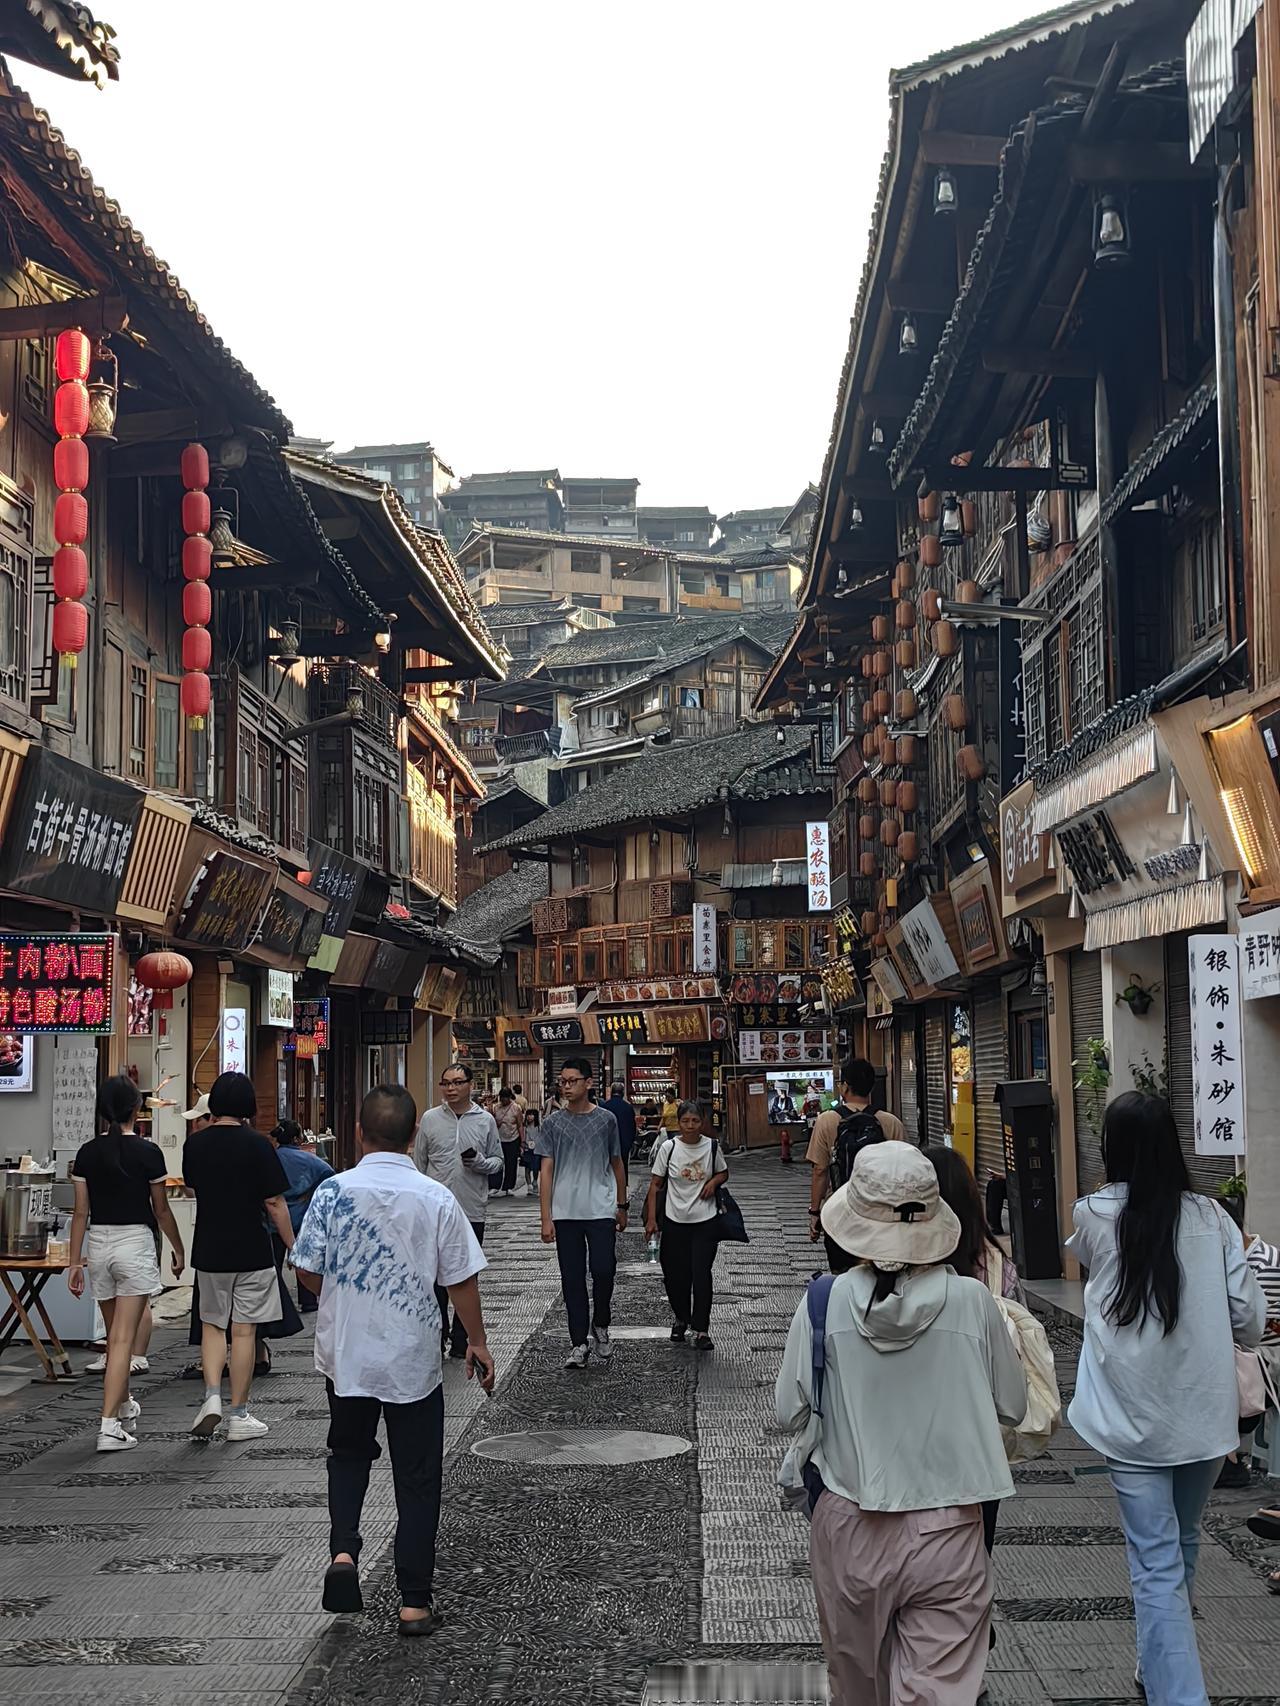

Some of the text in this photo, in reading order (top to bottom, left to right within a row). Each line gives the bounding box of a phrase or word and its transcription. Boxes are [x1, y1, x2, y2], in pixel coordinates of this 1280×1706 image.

[27, 789, 132, 878] 古街牛骨汤粉面馆
[810, 825, 828, 908] 惠农酸汤
[225, 1037, 240, 1071] 朱砂
